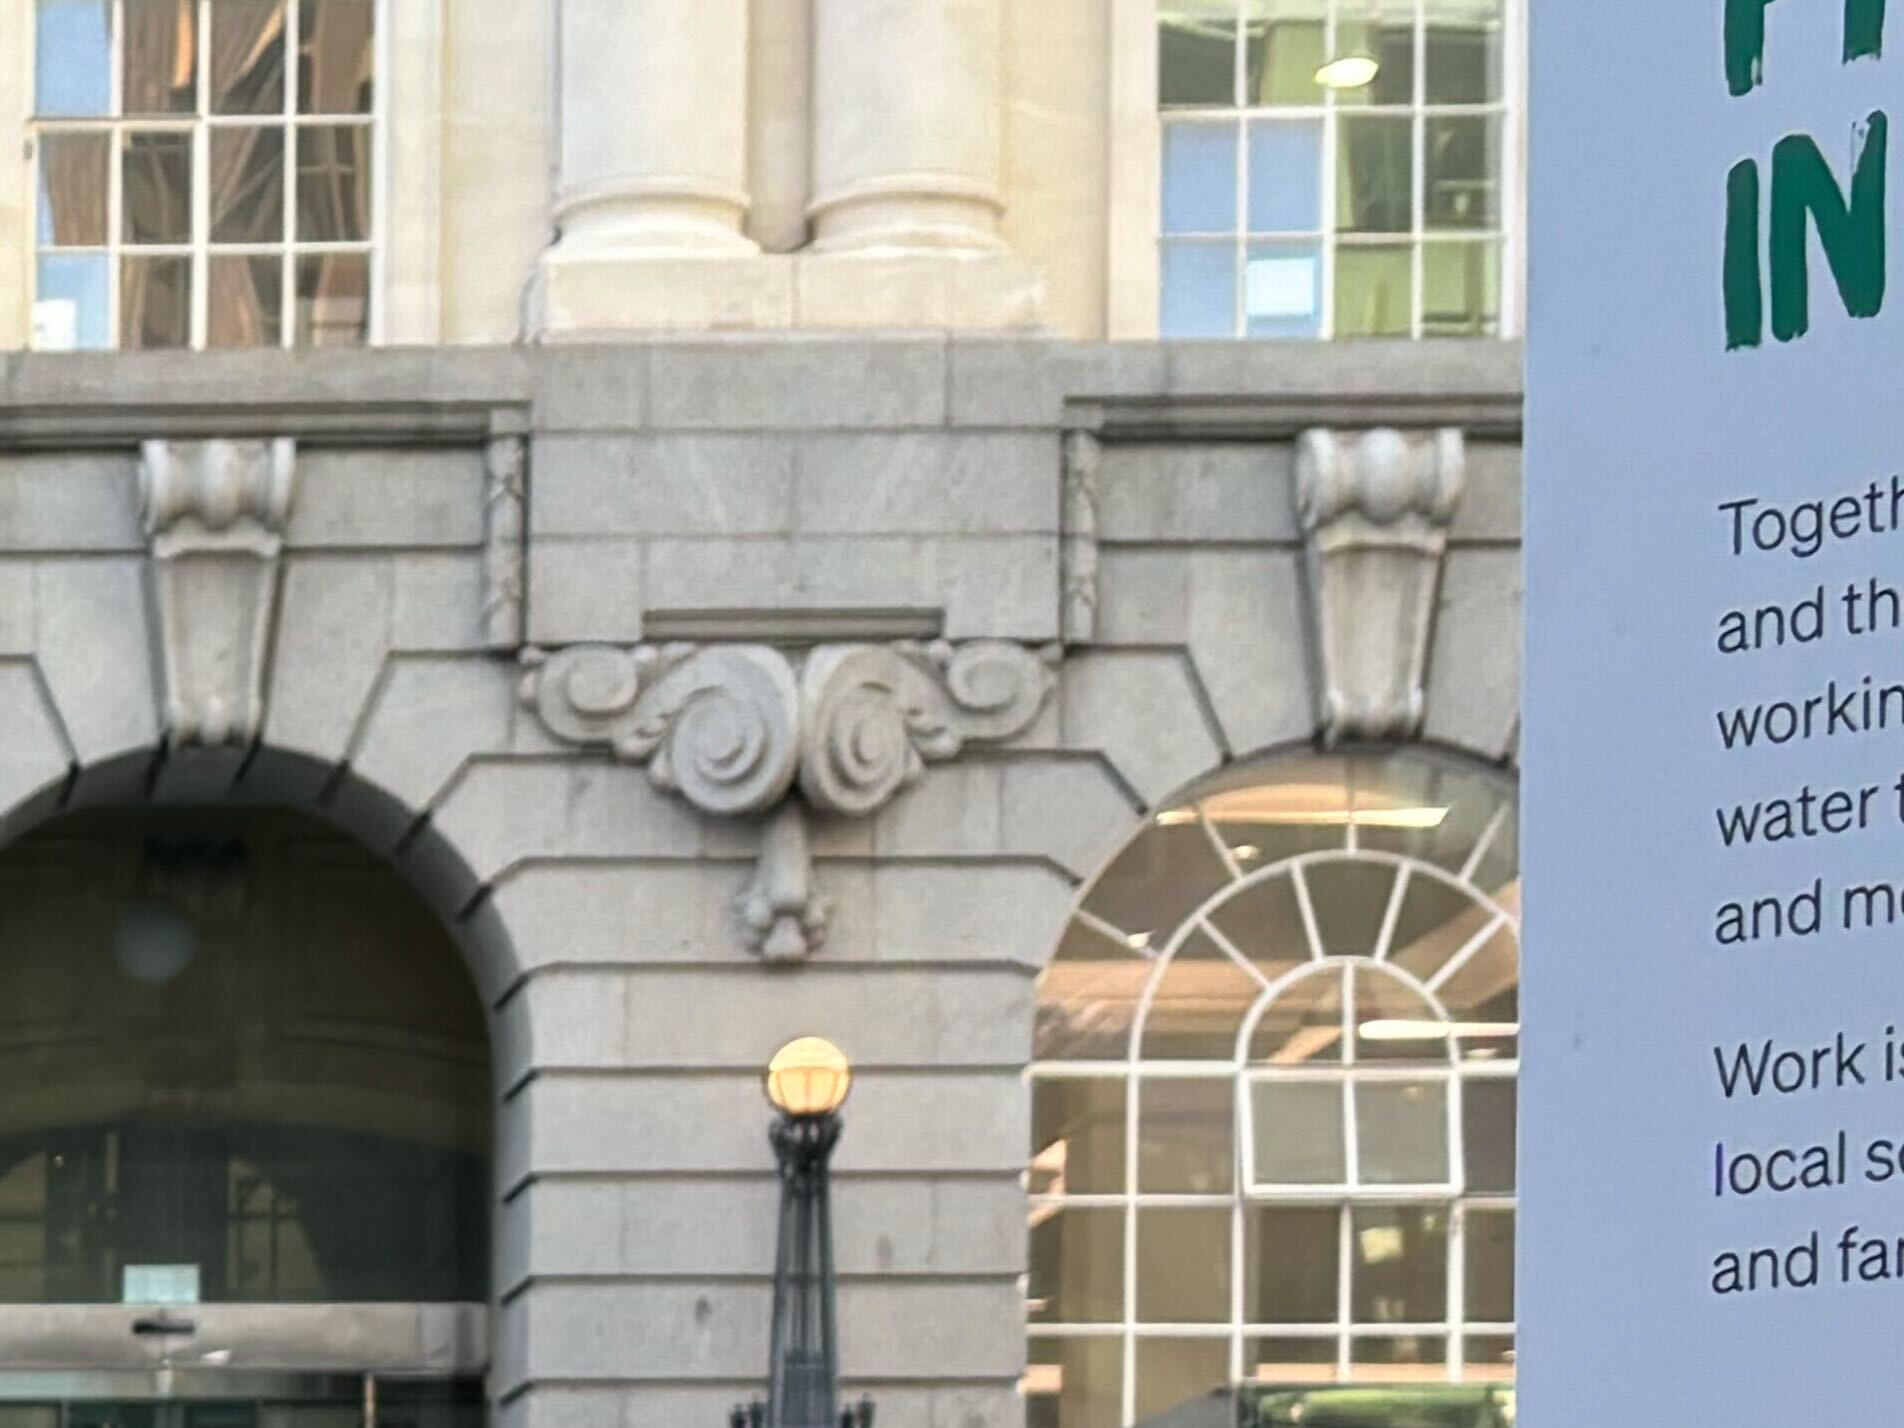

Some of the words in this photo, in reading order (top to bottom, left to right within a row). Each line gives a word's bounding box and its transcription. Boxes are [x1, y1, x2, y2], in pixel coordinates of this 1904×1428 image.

[1722, 108, 1888, 352] IN
[1717, 585, 1824, 654] and
[1714, 782, 1882, 848] water
[1715, 878, 1822, 945] and
[1842, 882, 1904, 930] m
[1713, 1031, 1866, 1099] Work
[1715, 1130, 1846, 1197] local
[1711, 1230, 1819, 1295] and
